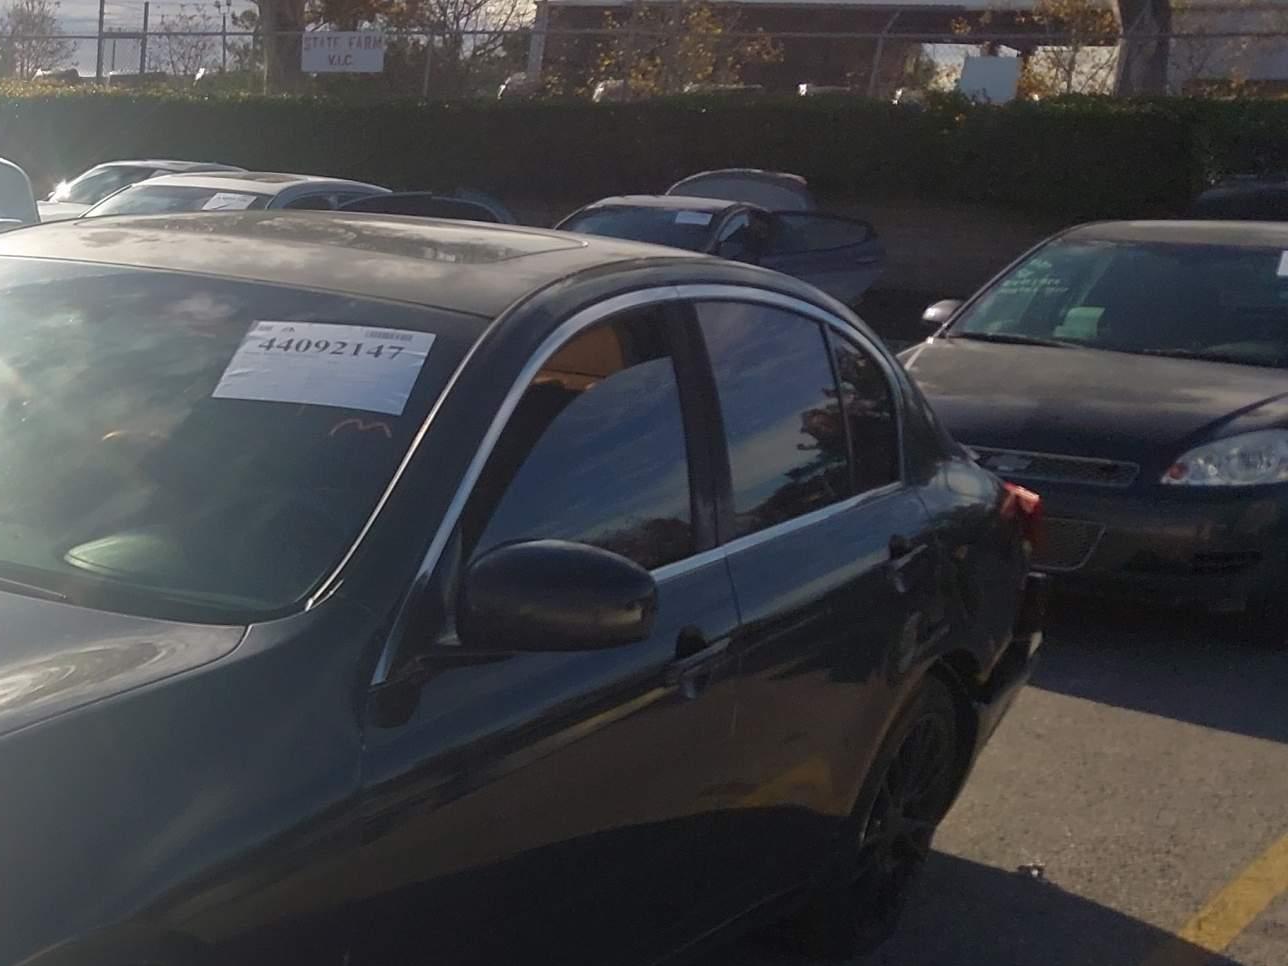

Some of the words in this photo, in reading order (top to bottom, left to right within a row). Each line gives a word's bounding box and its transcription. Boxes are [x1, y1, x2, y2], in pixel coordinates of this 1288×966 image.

[303, 35, 339, 50] STATE
[349, 35, 383, 50] FARM
[258, 336, 406, 361] 44092147
